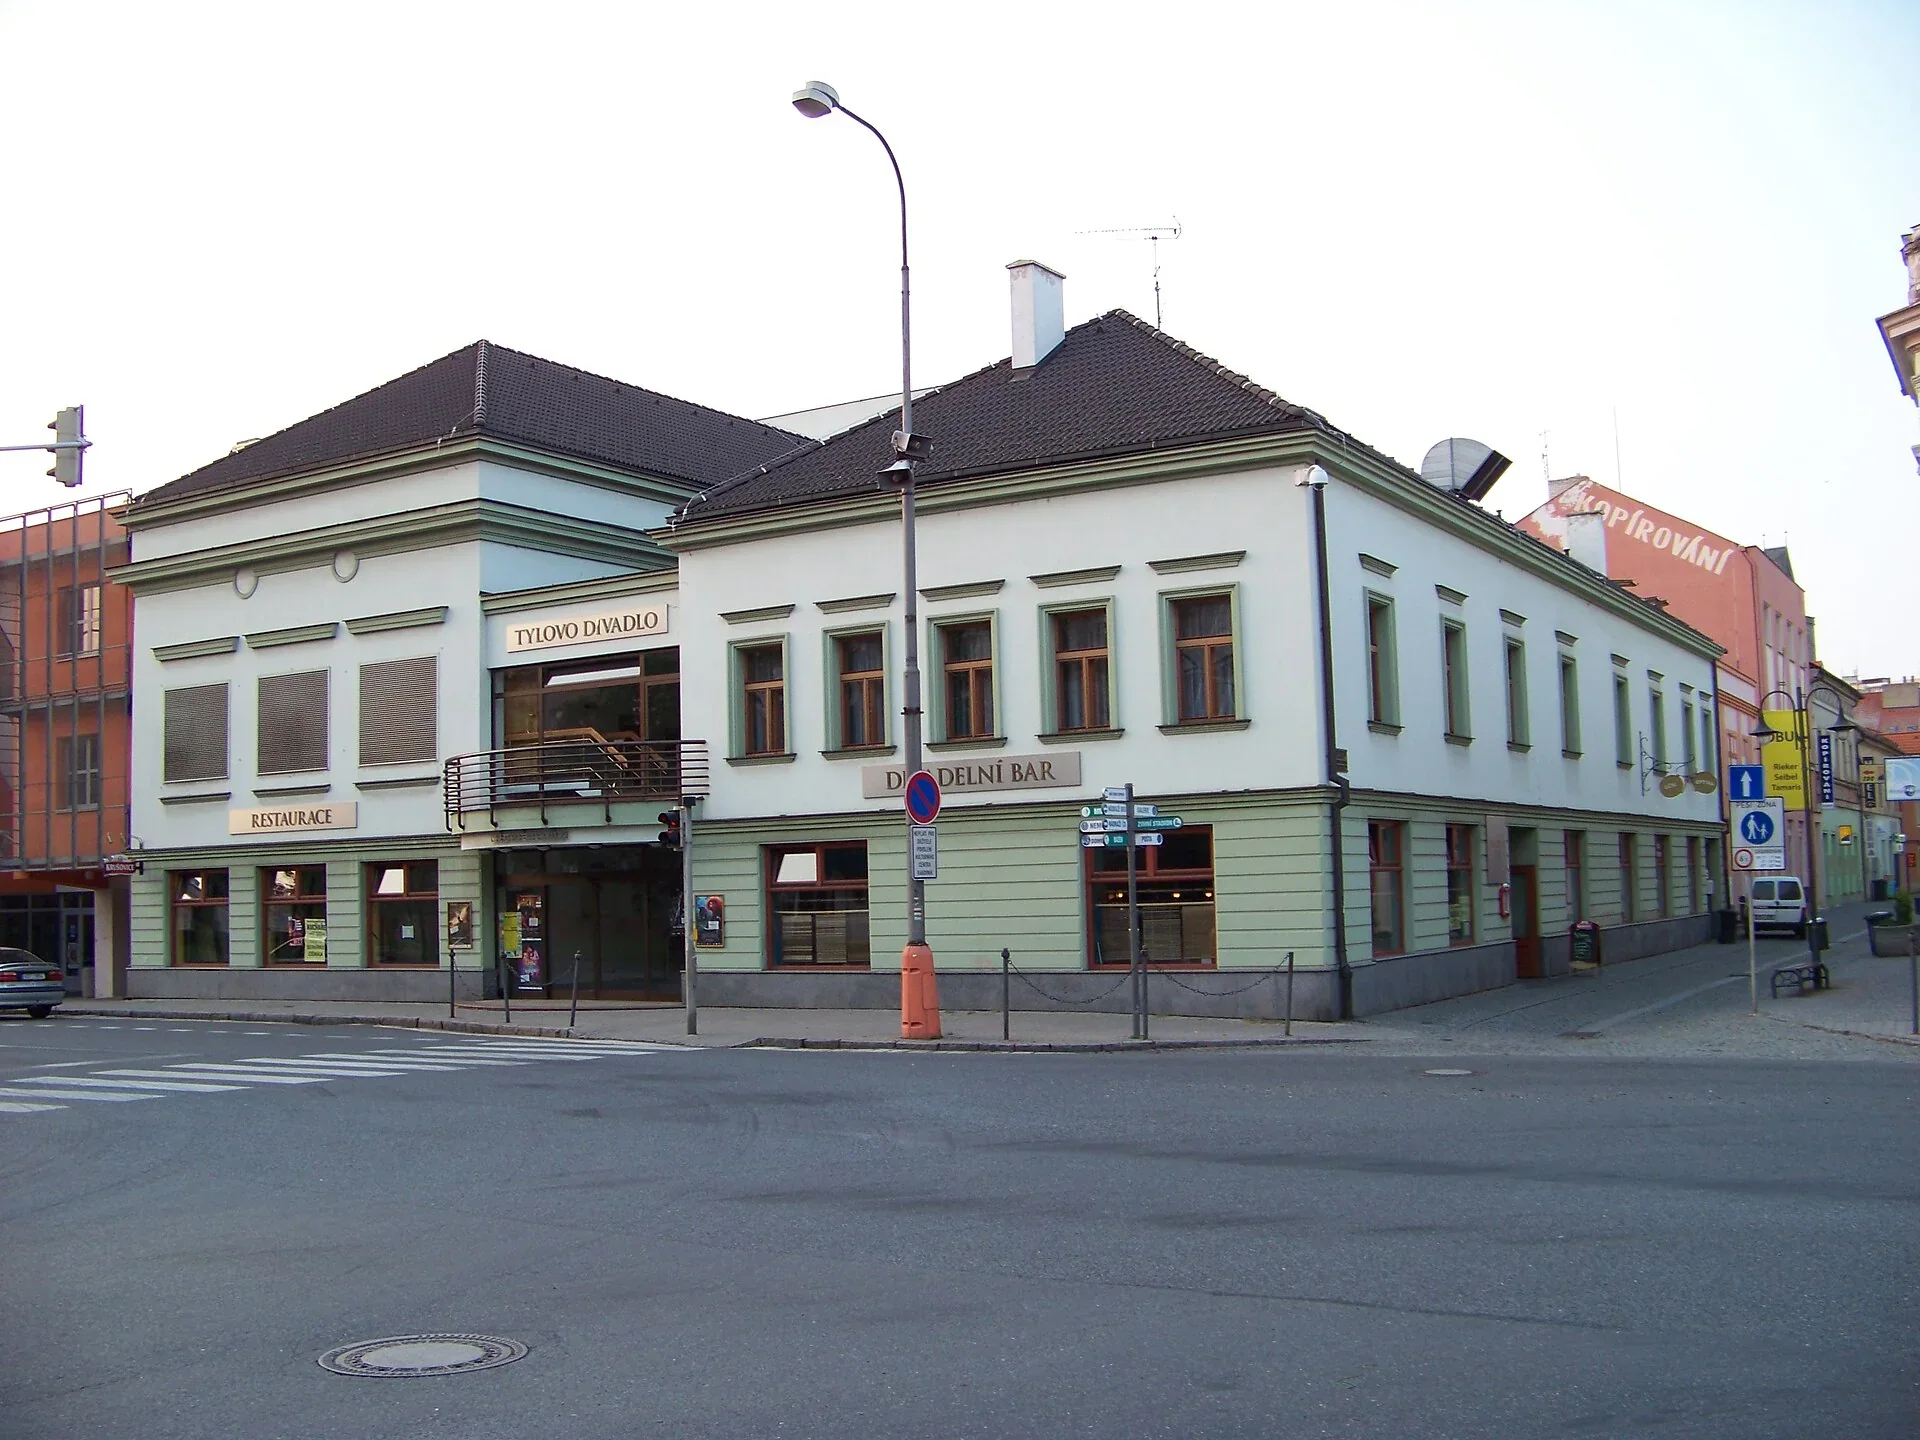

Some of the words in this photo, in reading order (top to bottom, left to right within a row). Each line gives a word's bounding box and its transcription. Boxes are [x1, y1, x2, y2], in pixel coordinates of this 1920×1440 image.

[1573, 491, 1735, 576] KOPÍROVÁNÍ
[515, 622, 578, 646] TYLOVO
[583, 611, 659, 637] DIVADLO
[885, 759, 1003, 790] DIDELNÍ
[1010, 760, 1056, 783] BAR
[251, 809, 333, 828] RESTAURACE
